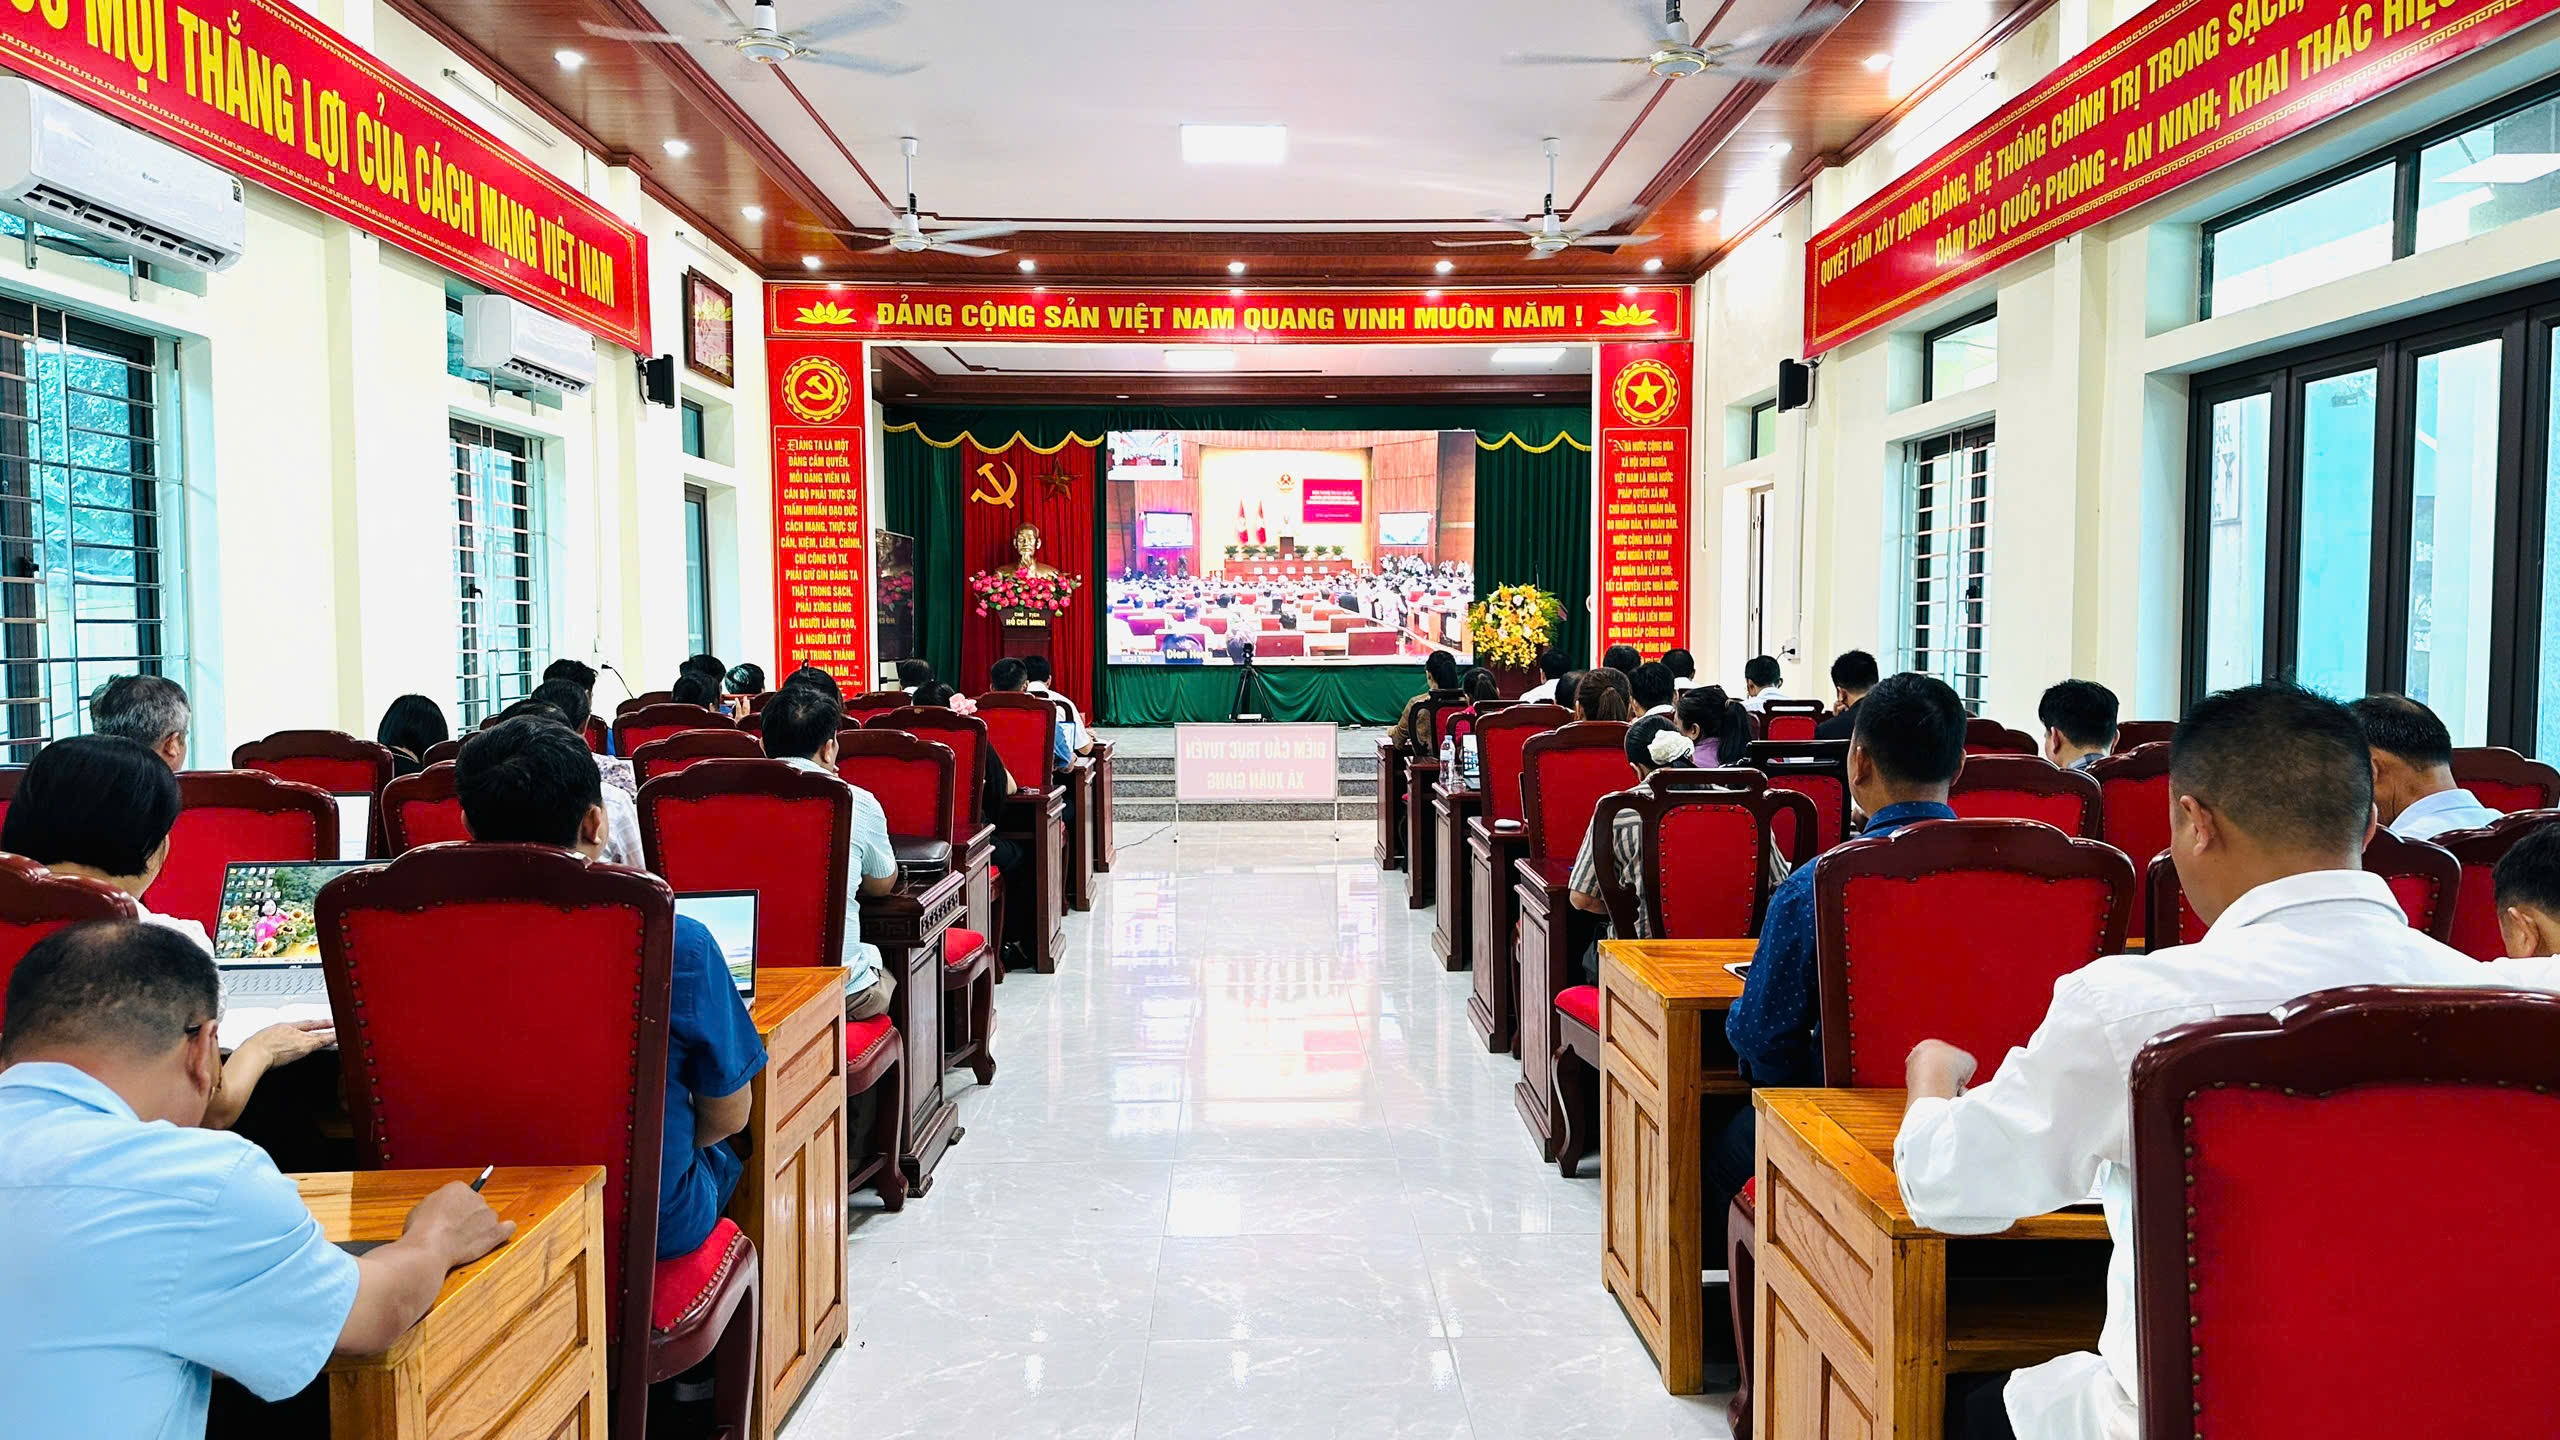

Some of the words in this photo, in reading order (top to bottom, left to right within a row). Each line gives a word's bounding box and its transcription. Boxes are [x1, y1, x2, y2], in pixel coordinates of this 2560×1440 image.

[177, 6, 296, 147] THẮNG
[302, 78, 349, 184] LỢI
[356, 92, 410, 204] CỦA
[415, 141, 476, 238] CÁCH
[479, 181, 538, 268] MẠNG
[540, 215, 576, 296] VIỆT
[578, 239, 615, 308] NAM
[1820, 240, 1850, 287] QUYẾT
[1851, 229, 1872, 268] TÂM
[1874, 215, 1895, 254] XÂY
[1897, 196, 1930, 241] DỰNG
[1932, 175, 1971, 220] ĐẢNG,
[1975, 152, 1993, 195] HỆ
[1996, 122, 2047, 181] THỐNG
[2050, 91, 2106, 149] CHÍNH
[2111, 73, 2141, 110] TRỊ
[2147, 27, 2220, 91] TRONG
[1935, 222, 1965, 267] ĐẢM
[1968, 202, 1996, 250] BẢO
[2000, 176, 2041, 234] QUỐC
[2045, 145, 2105, 213] PHÒNG
[2123, 122, 2153, 171] AN
[2158, 88, 2221, 153] NINH;
[2229, 46, 2290, 118] KHAI
[2297, 3, 2374, 80] THÁC
[2383, 0, 2455, 38] HI
[877, 294, 953, 326] ĐẢNG
[961, 300, 1036, 332] CỘNG
[1044, 297, 1099, 329] SẢN
[1109, 303, 1165, 334] VIỆT
[1172, 307, 1235, 329] NAM
[1244, 306, 1335, 332] QUANG
[1343, 307, 1405, 329] VINH
[1414, 302, 1495, 329] MUÔN
[1503, 302, 1565, 328] NĂM
[1575, 307, 1583, 328] !
[1006, 616, 1016, 626] HỒ
[1016, 618, 1028, 626] CHÍ
